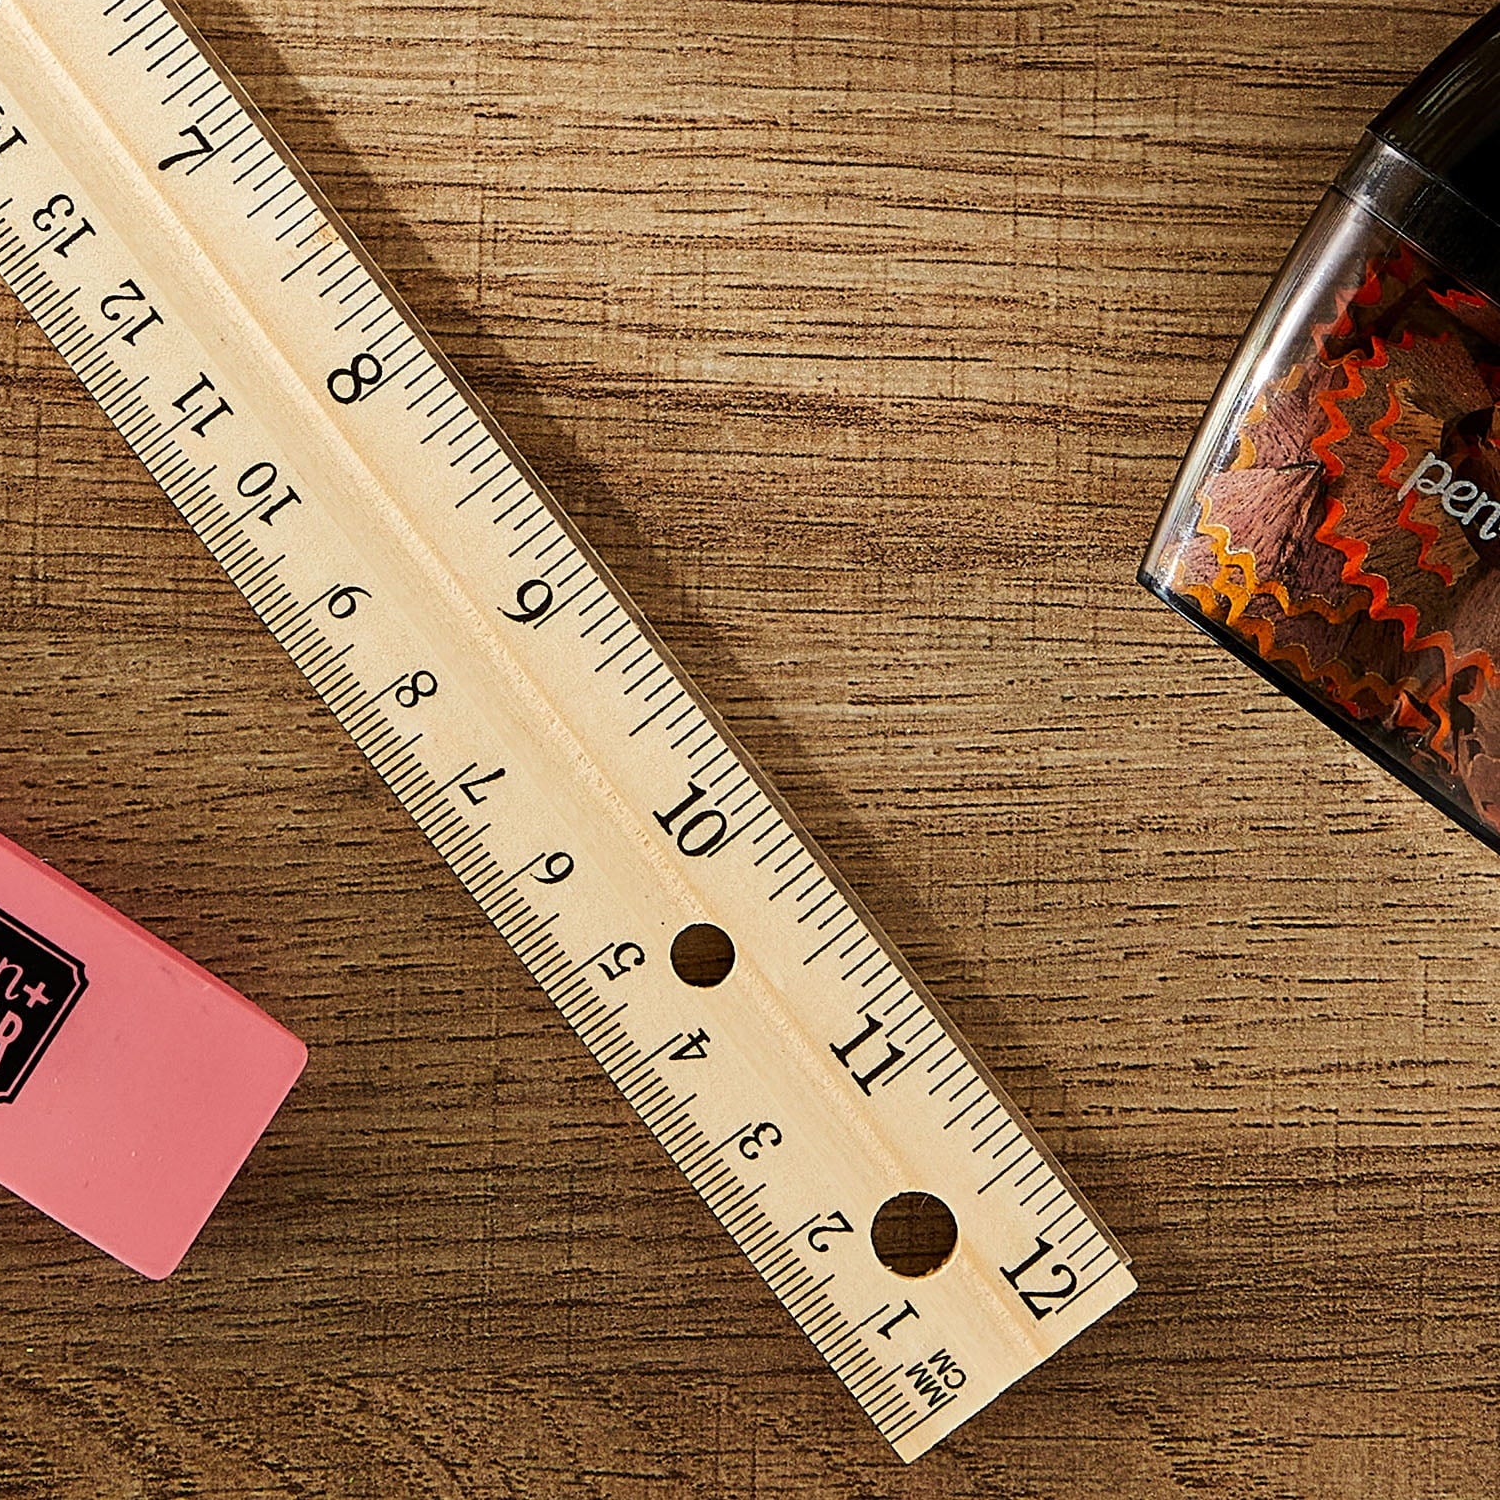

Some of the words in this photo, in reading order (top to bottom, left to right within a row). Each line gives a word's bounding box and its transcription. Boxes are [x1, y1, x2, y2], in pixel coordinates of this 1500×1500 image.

[158, 125, 213, 170] 7
[33, 194, 96, 258] 13
[101, 279, 163, 346] 12
[327, 353, 382, 405] 8
[172, 372, 233, 437] 11
[237, 463, 301, 526] 10
[328, 587, 372, 618] 9
[498, 579, 554, 625] 9
[395, 671, 437, 708] 8
[459, 768, 505, 805] 7
[653, 782, 727, 856] 10
[534, 852, 574, 884] 6
[598, 943, 645, 980] 5
[669, 1028, 710, 1060] 4
[829, 1013, 905, 1096] 11
[739, 1123, 782, 1160] 3
[808, 1211, 853, 1252] 2
[1000, 1237, 1077, 1320] 12
[877, 1300, 919, 1340] 1
[905, 1361, 948, 1408] MM
[927, 1348, 967, 1389] CM
